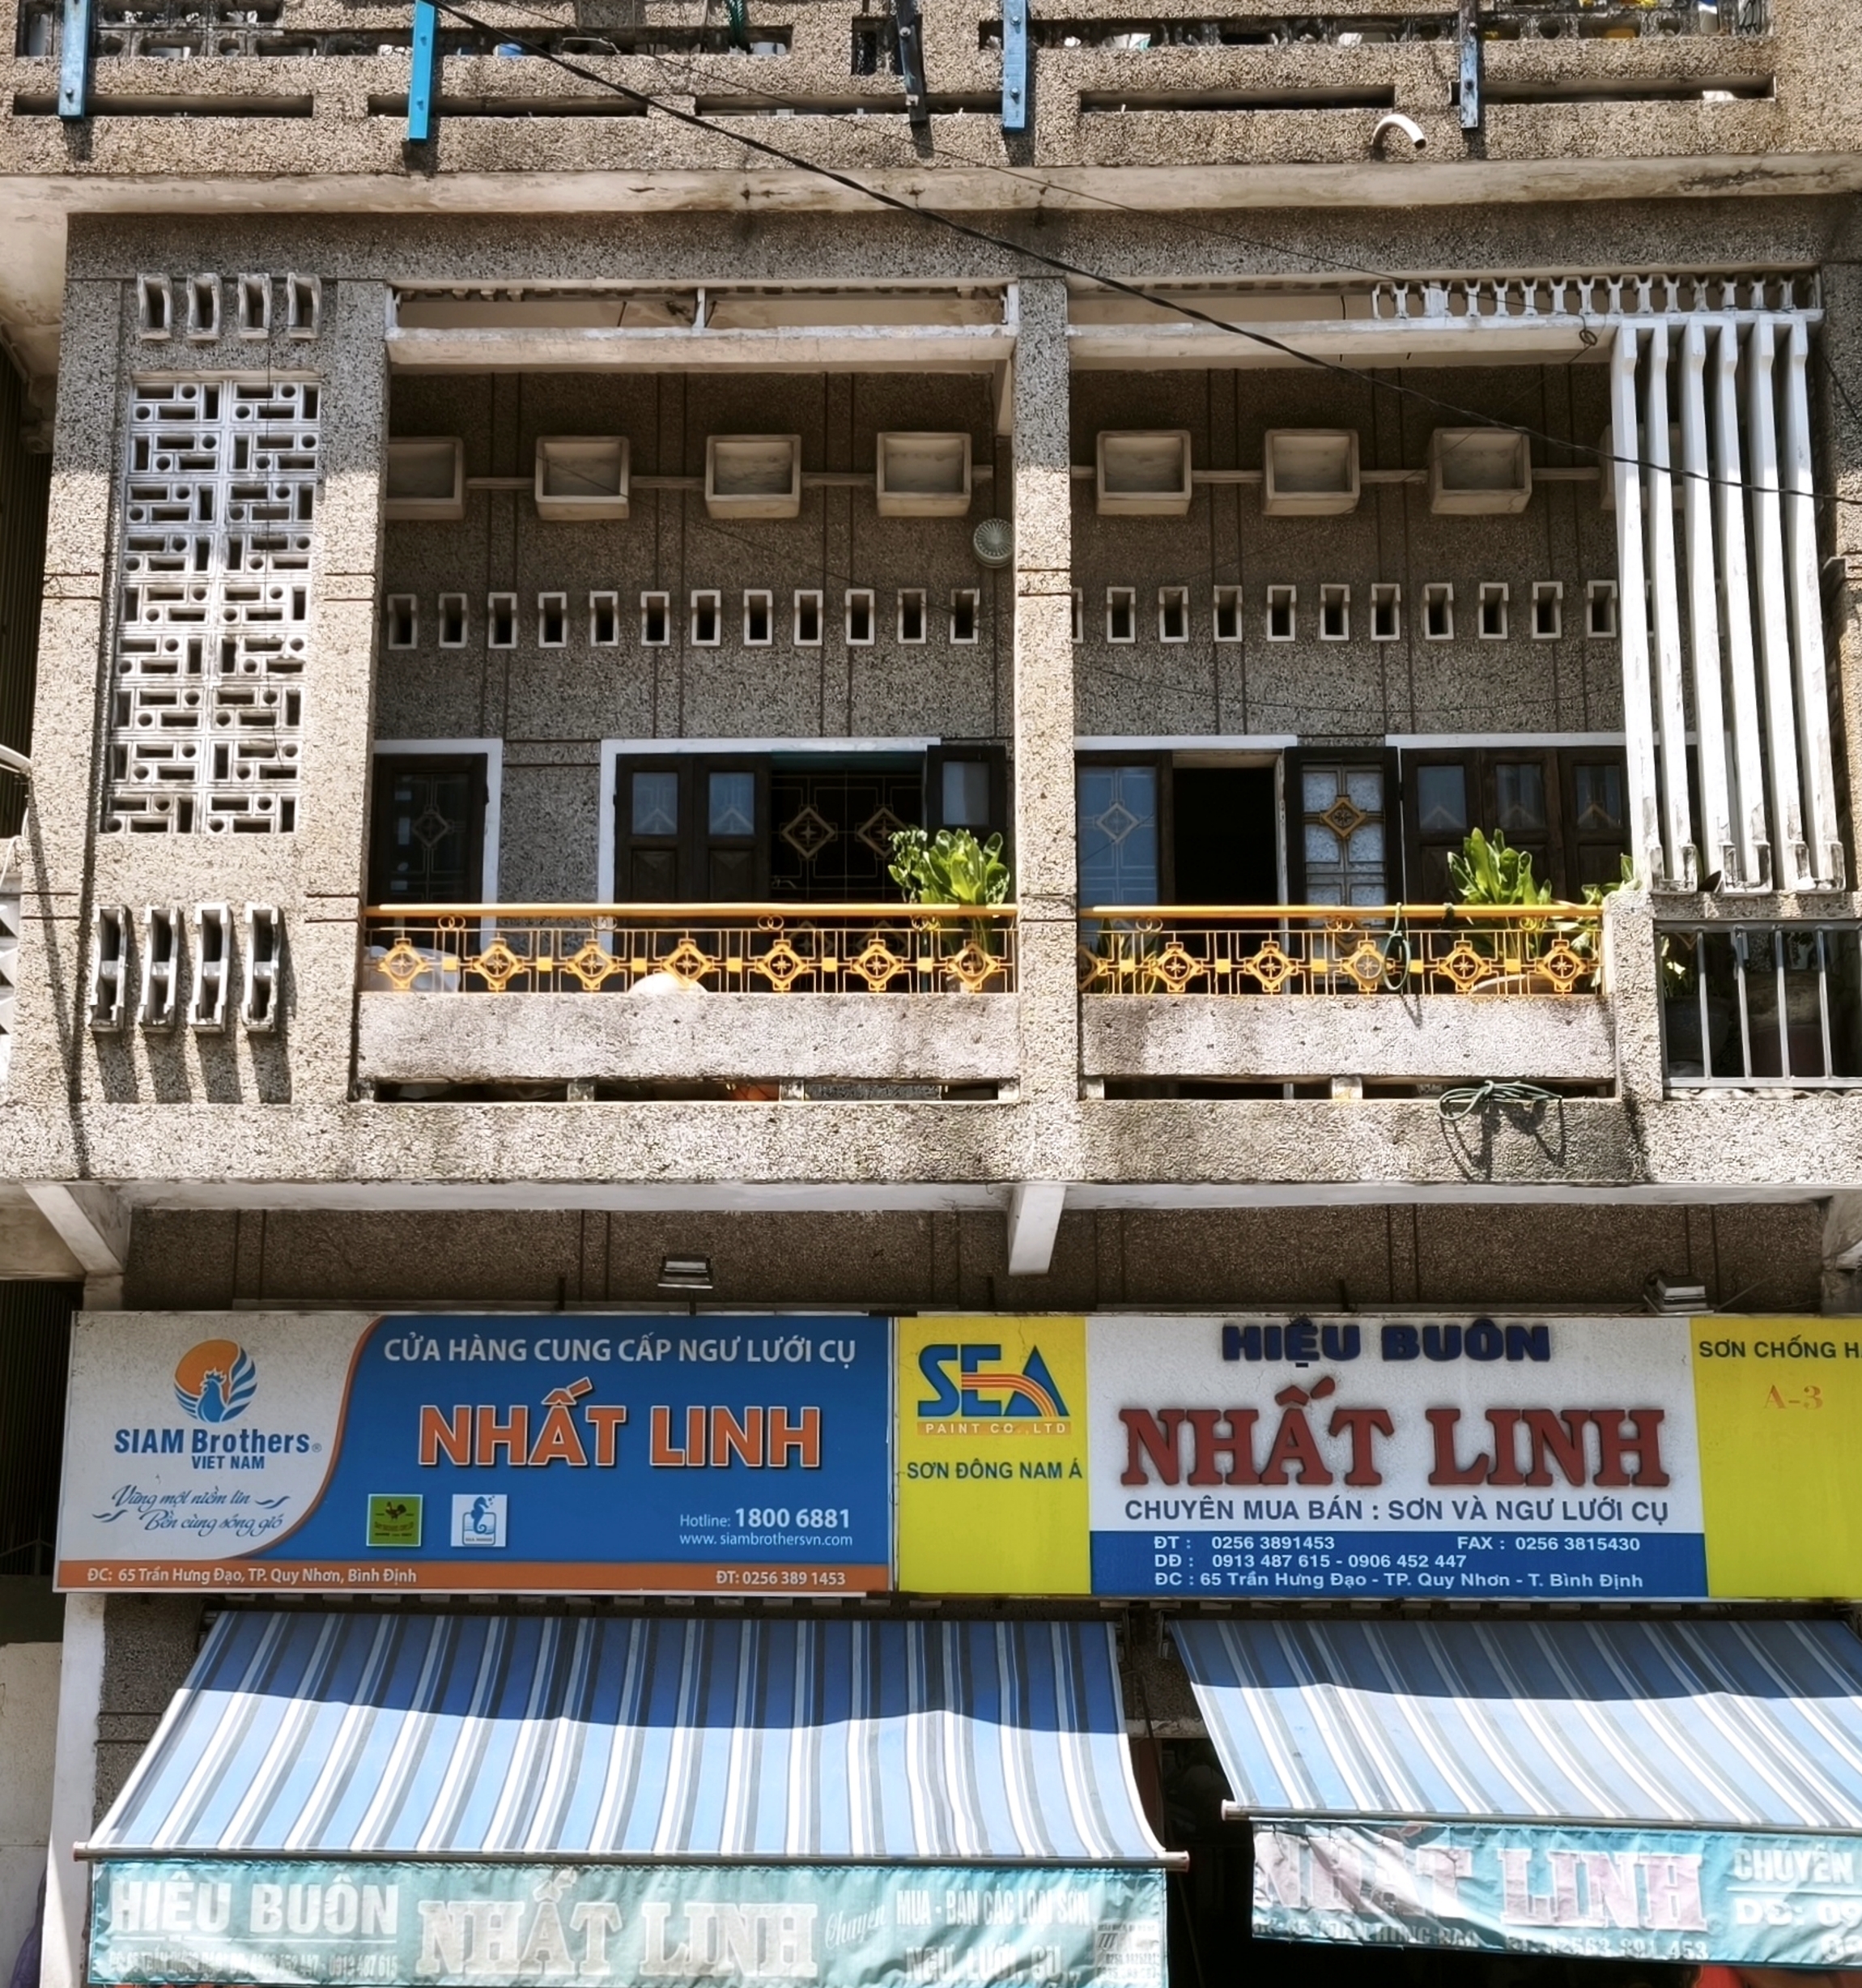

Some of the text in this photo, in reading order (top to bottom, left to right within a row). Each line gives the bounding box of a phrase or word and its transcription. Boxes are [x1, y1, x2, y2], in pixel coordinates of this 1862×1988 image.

[384, 1331, 856, 1369] CỬA HÀNG CUNG CẤP NGƯ LƯỚI CỤ
[1222, 1318, 1551, 1368] HIỆU BUÔN
[1699, 1335, 1862, 1359] SƠN CHỐNG H
[917, 1343, 1070, 1417] SEA
[1764, 1385, 1823, 1409] A-3
[418, 1377, 823, 1468] NHẤT LINH
[926, 1423, 980, 1434] PAINT
[1118, 1376, 1671, 1487] NHẤT LINH
[114, 1429, 185, 1454] SIAM
[192, 1456, 265, 1470] VIET NAM
[907, 1458, 1083, 1479] SƠN ĐÔNG NAM Á
[680, 1508, 849, 1529] Hotline: 1800 6881
[1124, 1495, 1234, 1520] CHUYÊN
[1243, 1500, 1300, 1520] MUA
[1308, 1495, 1362, 1520] BÁN
[1388, 1498, 1443, 1521] SƠN
[1452, 1495, 1487, 1521] VÀ
[1497, 1498, 1554, 1521] NGƯ
[1562, 1496, 1622, 1522] LƯỚI
[1631, 1501, 1669, 1526] CỤ
[1211, 1536, 1255, 1550] 0256
[1260, 1536, 1335, 1550] 3891453
[1457, 1536, 1493, 1550] FAX
[1516, 1537, 1558, 1551] 0256
[1564, 1538, 1640, 1552] 3815430
[1212, 1555, 1255, 1568] 0913
[1260, 1555, 1292, 1568] 487
[1299, 1555, 1330, 1568] 615
[1348, 1555, 1391, 1568] 0906
[1396, 1555, 1429, 1568] 452
[1435, 1555, 1467, 1568] 447
[87, 1566, 417, 1585] ĐC: 65 Trần Hưng Đạo, TP. Quy Nhơn, Bình Định
[716, 1570, 845, 1586] ĐT: 0256 389 1453
[1200, 1573, 1222, 1586] 65
[1227, 1570, 1269, 1586] Trần
[1275, 1573, 1324, 1589] Hưng
[1330, 1573, 1367, 1589] Đạo
[1384, 1573, 1411, 1586] TP.
[1418, 1573, 1455, 1590] Quy
[1461, 1573, 1510, 1586] Nhơn
[1528, 1573, 1543, 1586] T.
[1550, 1573, 1592, 1587] Bình
[1599, 1573, 1643, 1590] Định
[1733, 1844, 1854, 1884] CHUYÊN
[1498, 1848, 1707, 1932] LINH
[896, 1889, 931, 1926] MUA
[946, 1883, 979, 1926] BÁN
[983, 1883, 1013, 1926] CÁC
[1057, 1888, 1090, 1926] SƠN
[250, 1873, 398, 1935] BUÔN
[415, 1867, 623, 1976] NHẤT
[640, 1901, 818, 1978] LINH
[378, 1954, 397, 1977] 615
